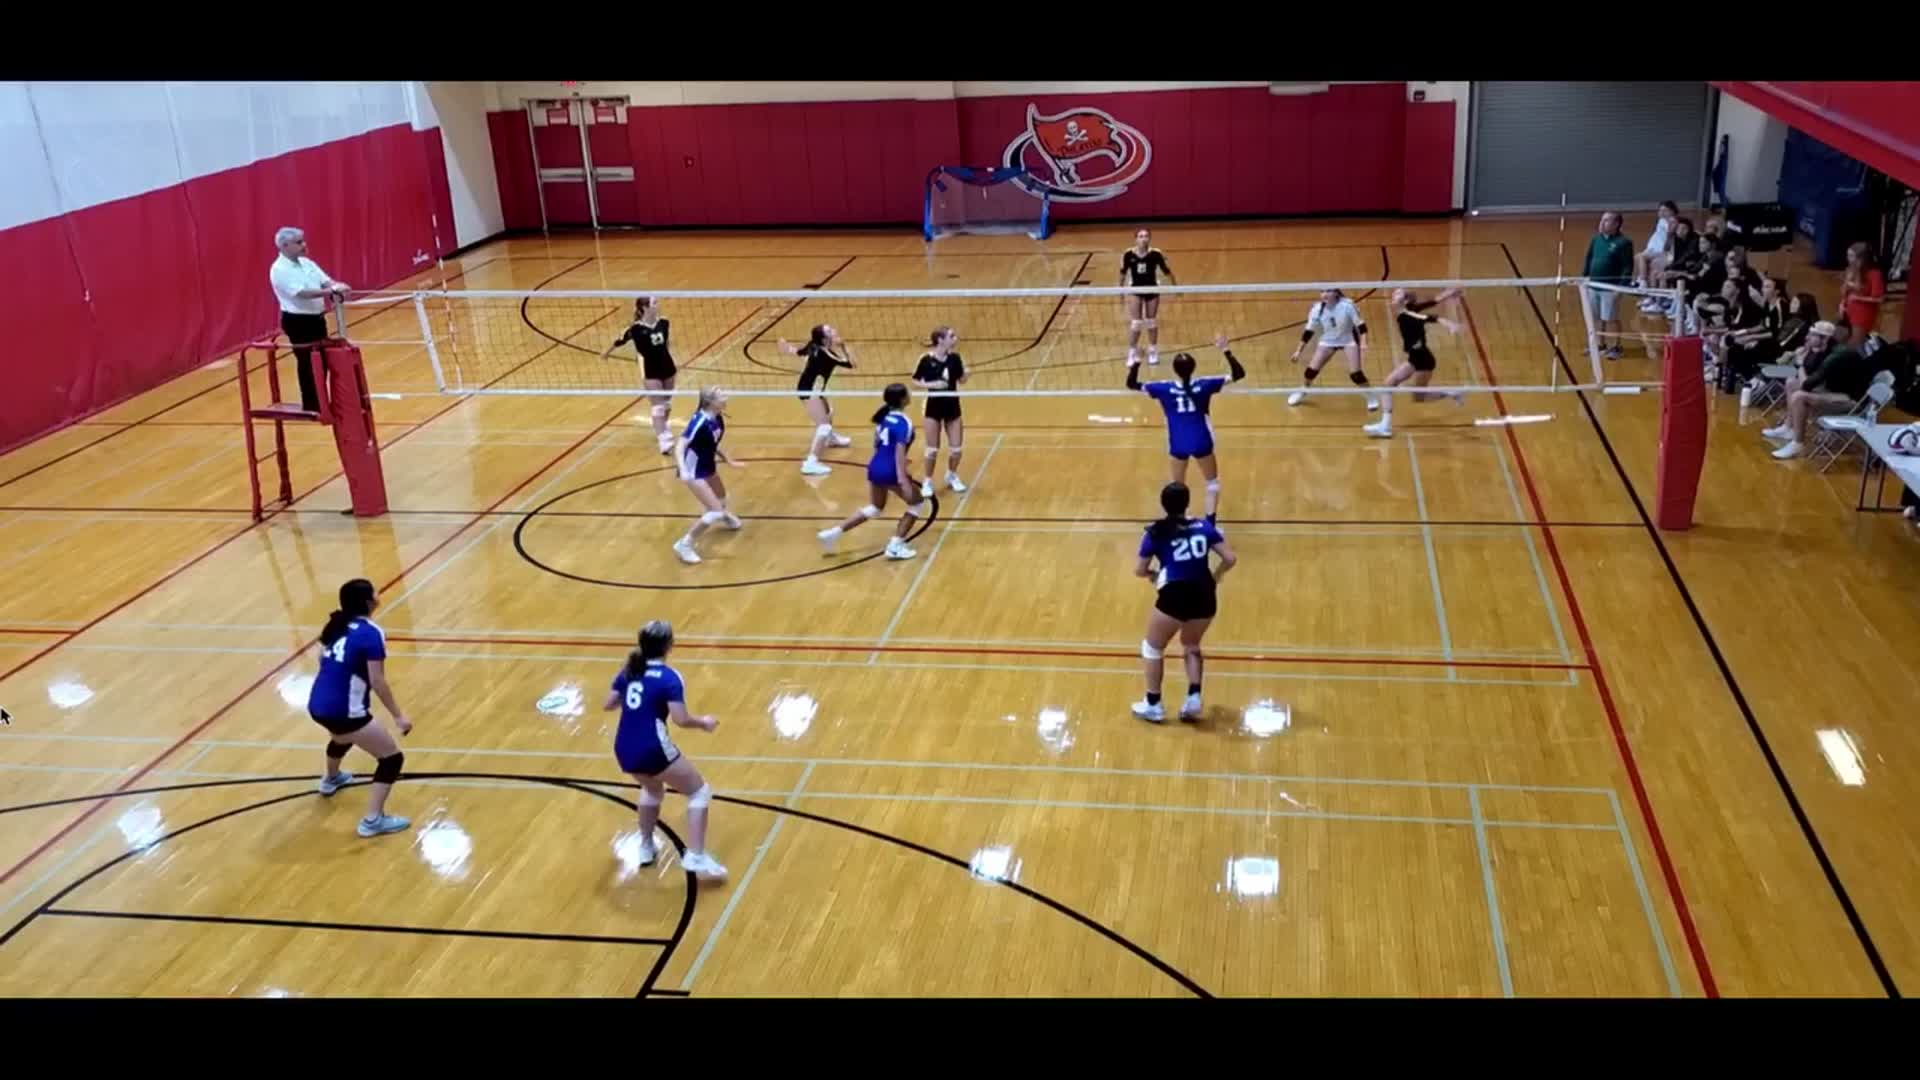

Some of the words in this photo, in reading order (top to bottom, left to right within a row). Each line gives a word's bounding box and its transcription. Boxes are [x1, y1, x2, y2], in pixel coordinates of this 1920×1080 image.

[1176, 396, 1196, 413] 11
[1170, 534, 1207, 562] 20
[626, 681, 644, 710] 6
